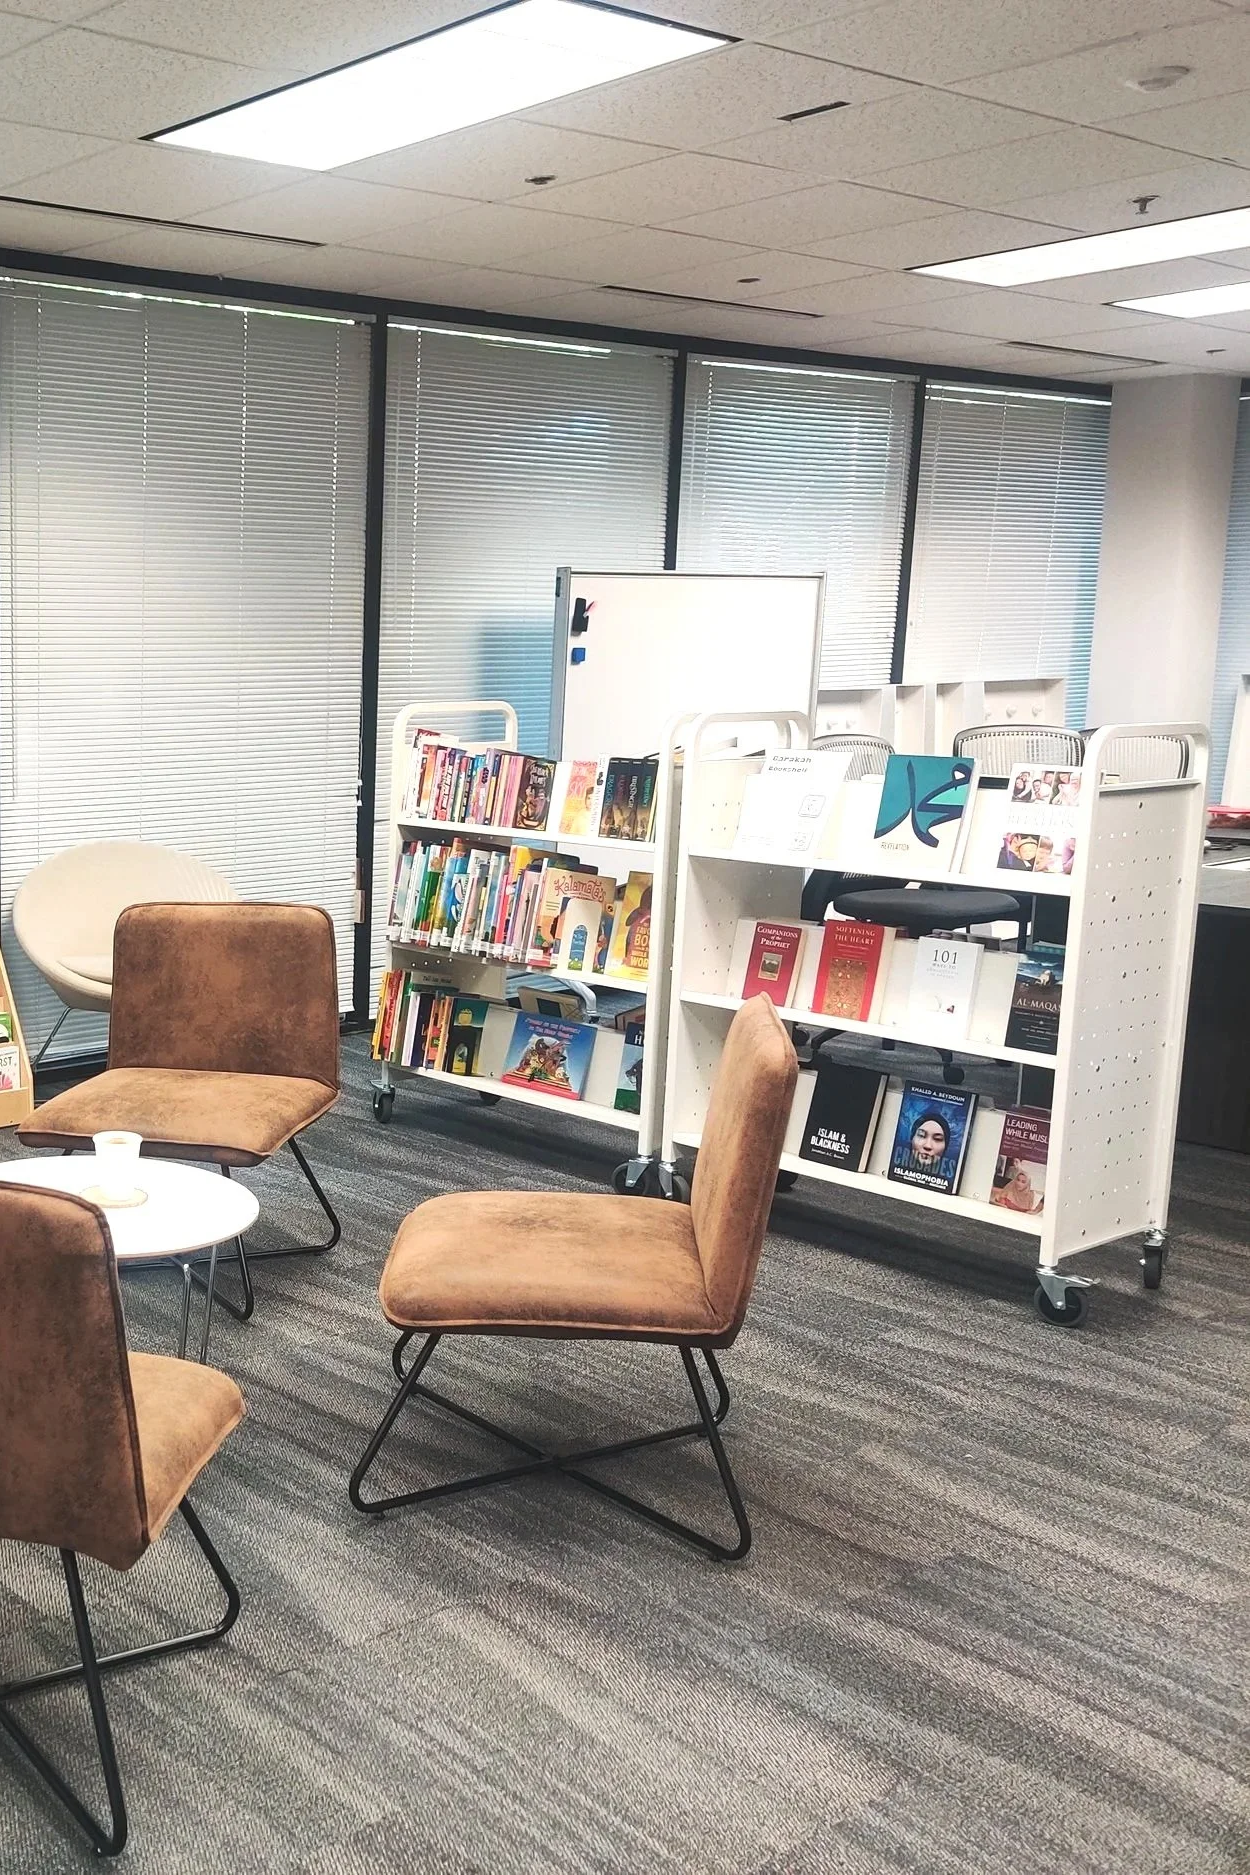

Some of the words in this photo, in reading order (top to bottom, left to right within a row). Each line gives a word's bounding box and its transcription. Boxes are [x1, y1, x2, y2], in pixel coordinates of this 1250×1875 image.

[554, 875, 607, 902] Kalamata's
[757, 925, 798, 938] COMPANIONS
[835, 925, 876, 937] SOFTENING
[760, 938, 791, 949] PROPHET
[850, 935, 874, 945] HEART
[933, 949, 958, 964] 101
[911, 1086, 932, 1095] KHALED
[939, 1093, 965, 1102] BEYDOUN
[1006, 1119, 1037, 1131] LEADING
[818, 1128, 840, 1141] ISLAM
[1005, 1128, 1029, 1139] WHILE
[811, 1135, 850, 1154] BLACKNESS
[894, 1146, 956, 1178] CRUSADES
[894, 1167, 949, 1187] ISLAMOPHOBIA
